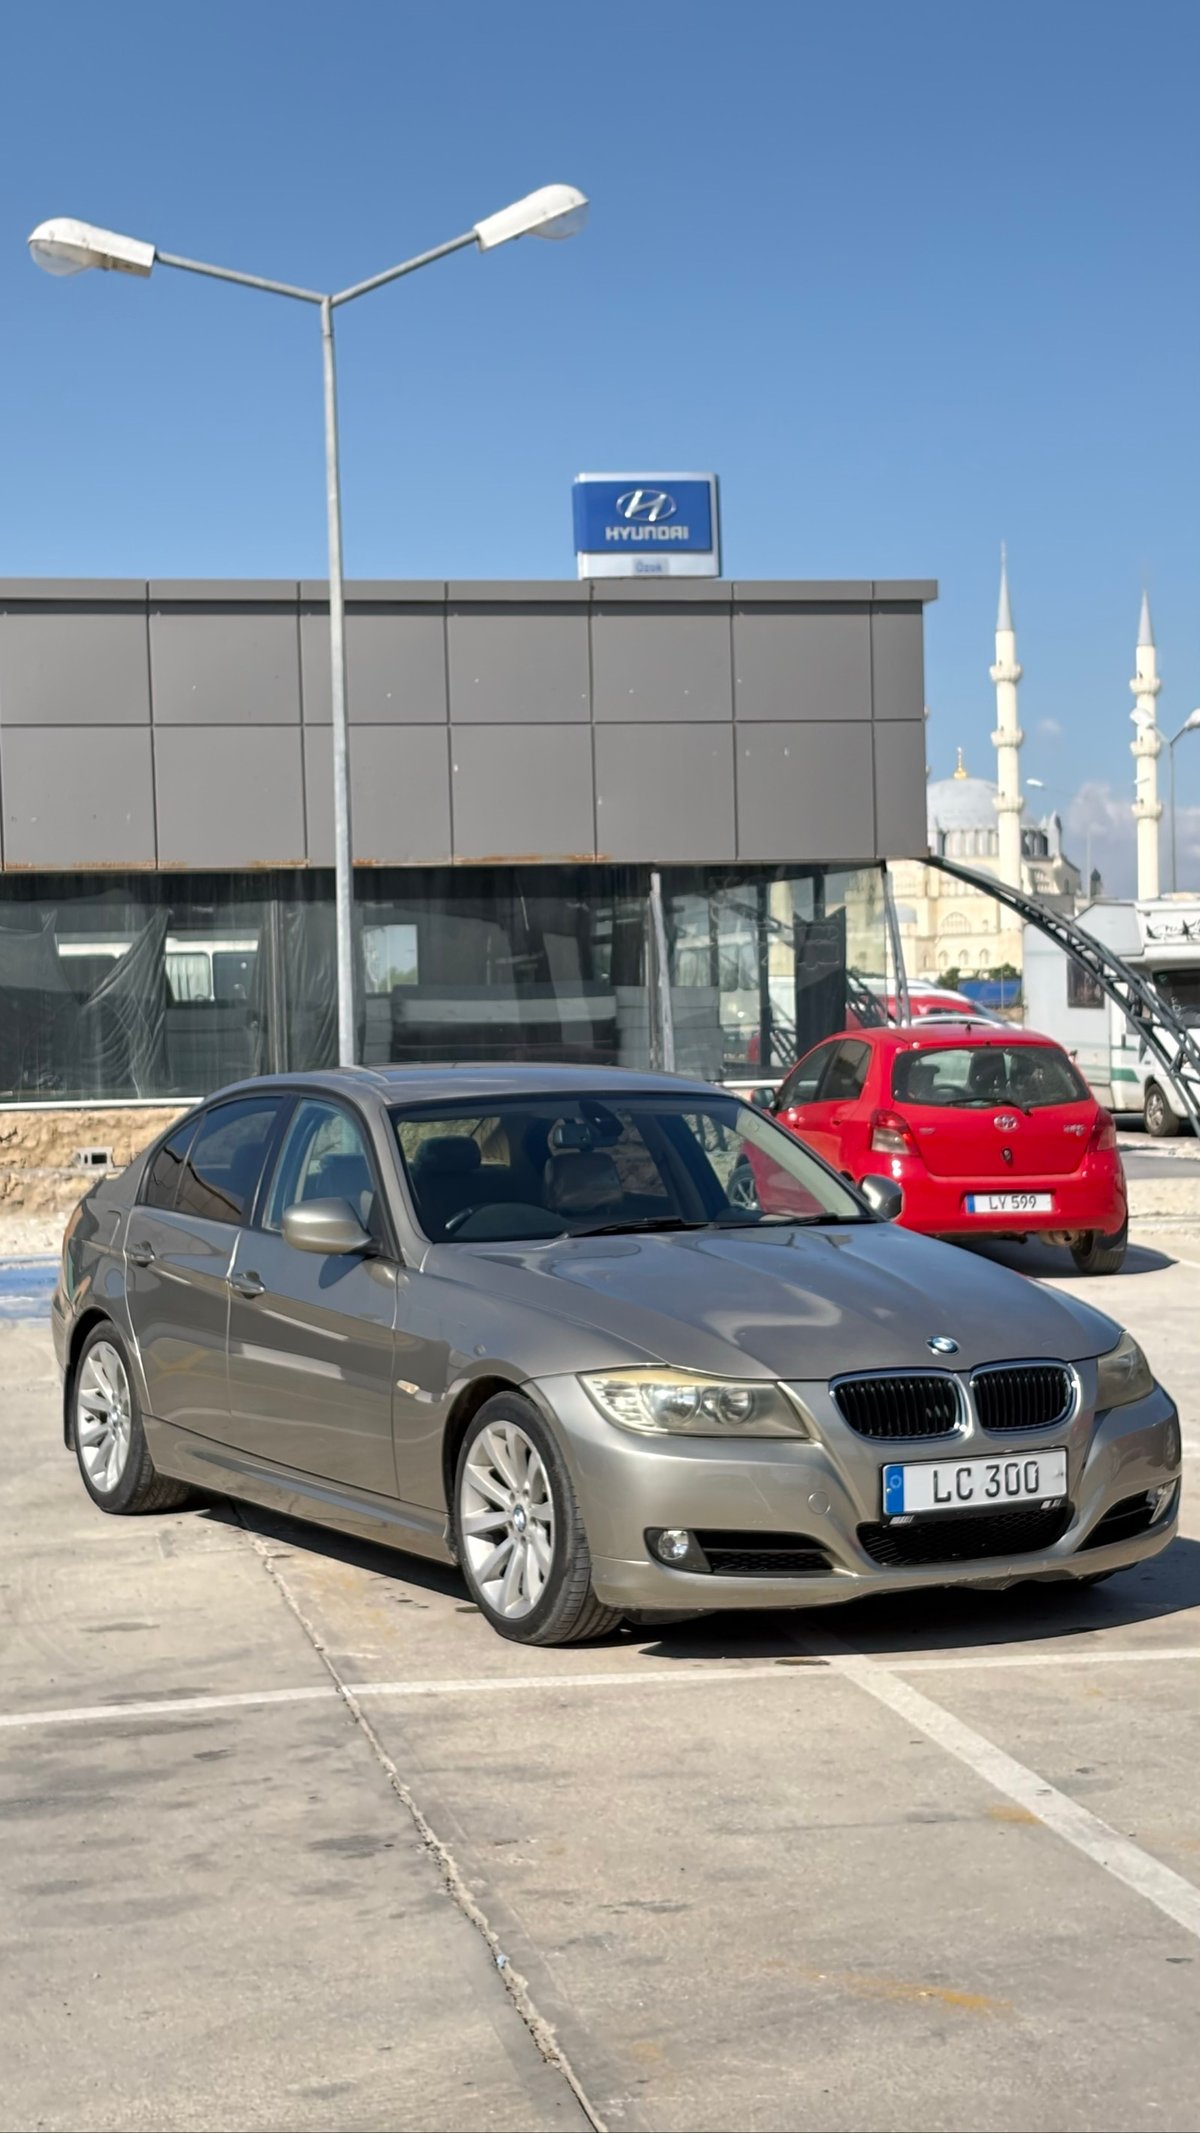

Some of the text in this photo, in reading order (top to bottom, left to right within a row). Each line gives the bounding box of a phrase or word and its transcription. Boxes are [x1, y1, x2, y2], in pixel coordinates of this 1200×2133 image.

[605, 526, 689, 540] HYUNDAI
[989, 1194, 1037, 1210] LY 599
[933, 1461, 1040, 1503] LC 300
